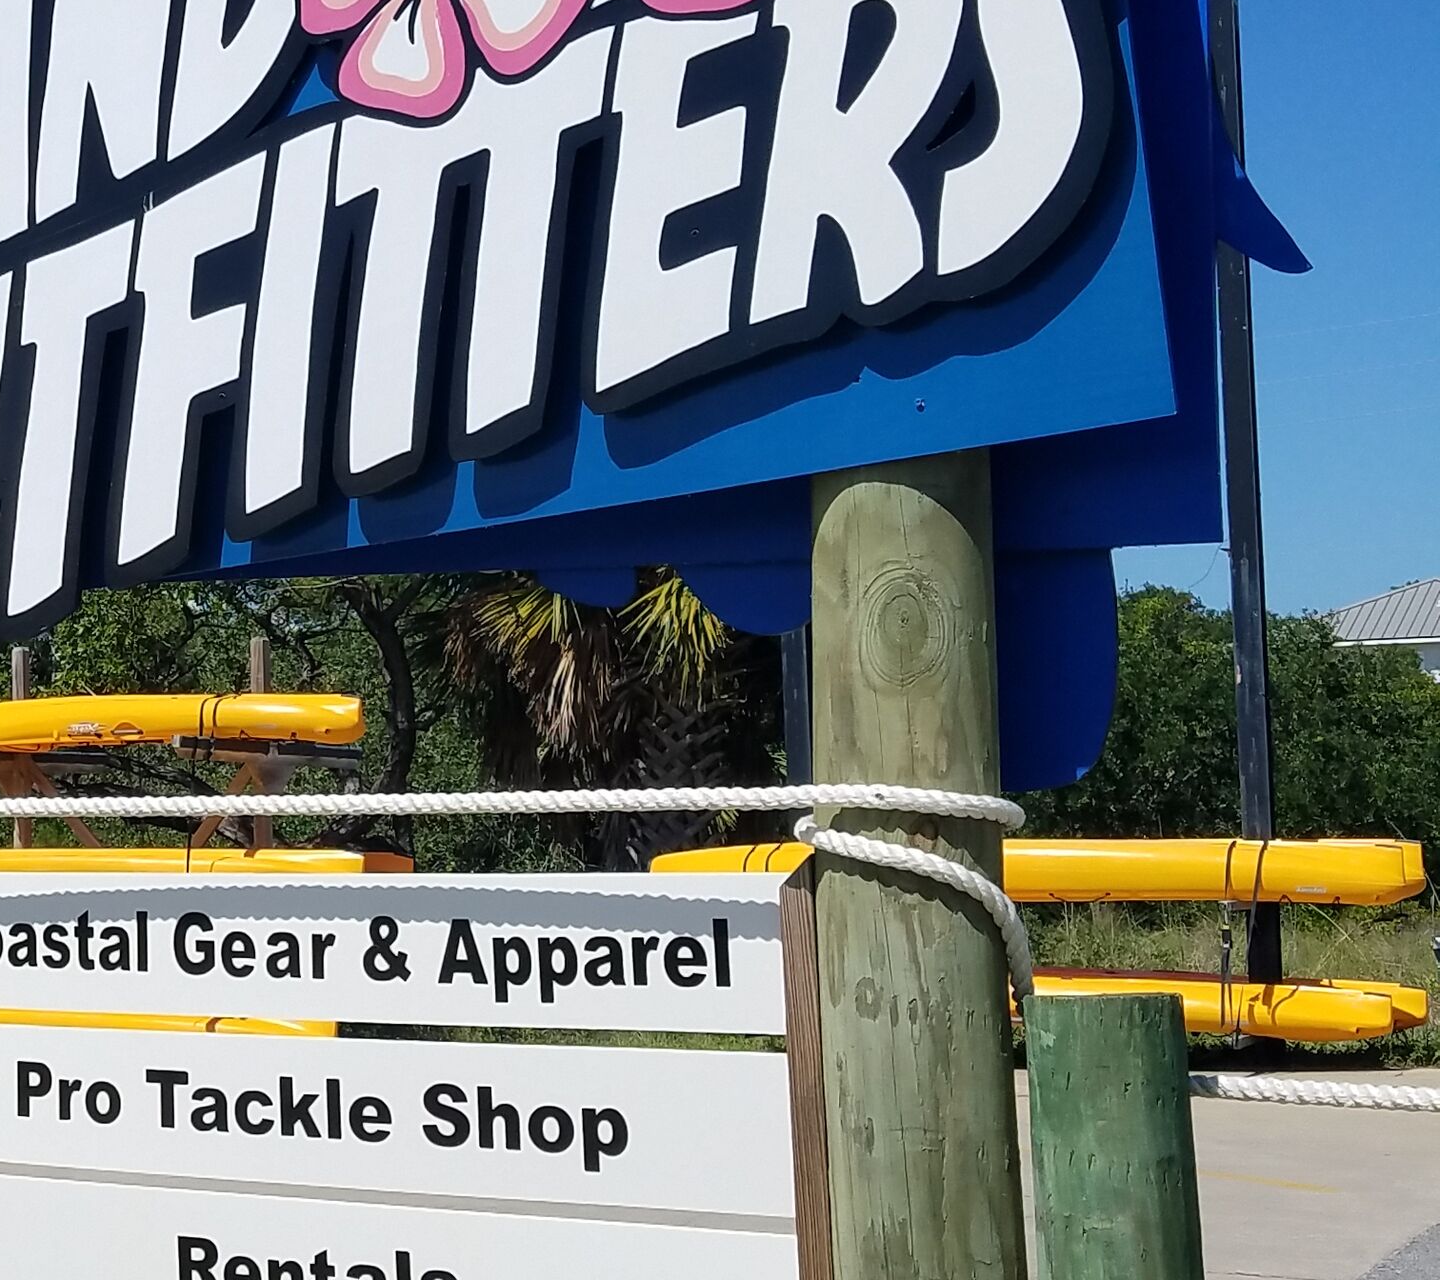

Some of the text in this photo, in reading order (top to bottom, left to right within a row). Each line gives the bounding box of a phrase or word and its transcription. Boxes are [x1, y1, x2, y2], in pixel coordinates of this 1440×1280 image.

[172, 910, 337, 981] Gear
[362, 914, 412, 983] &
[437, 916, 732, 1005] Apparel
[16, 1059, 629, 1174] Pro Tackle Shop
